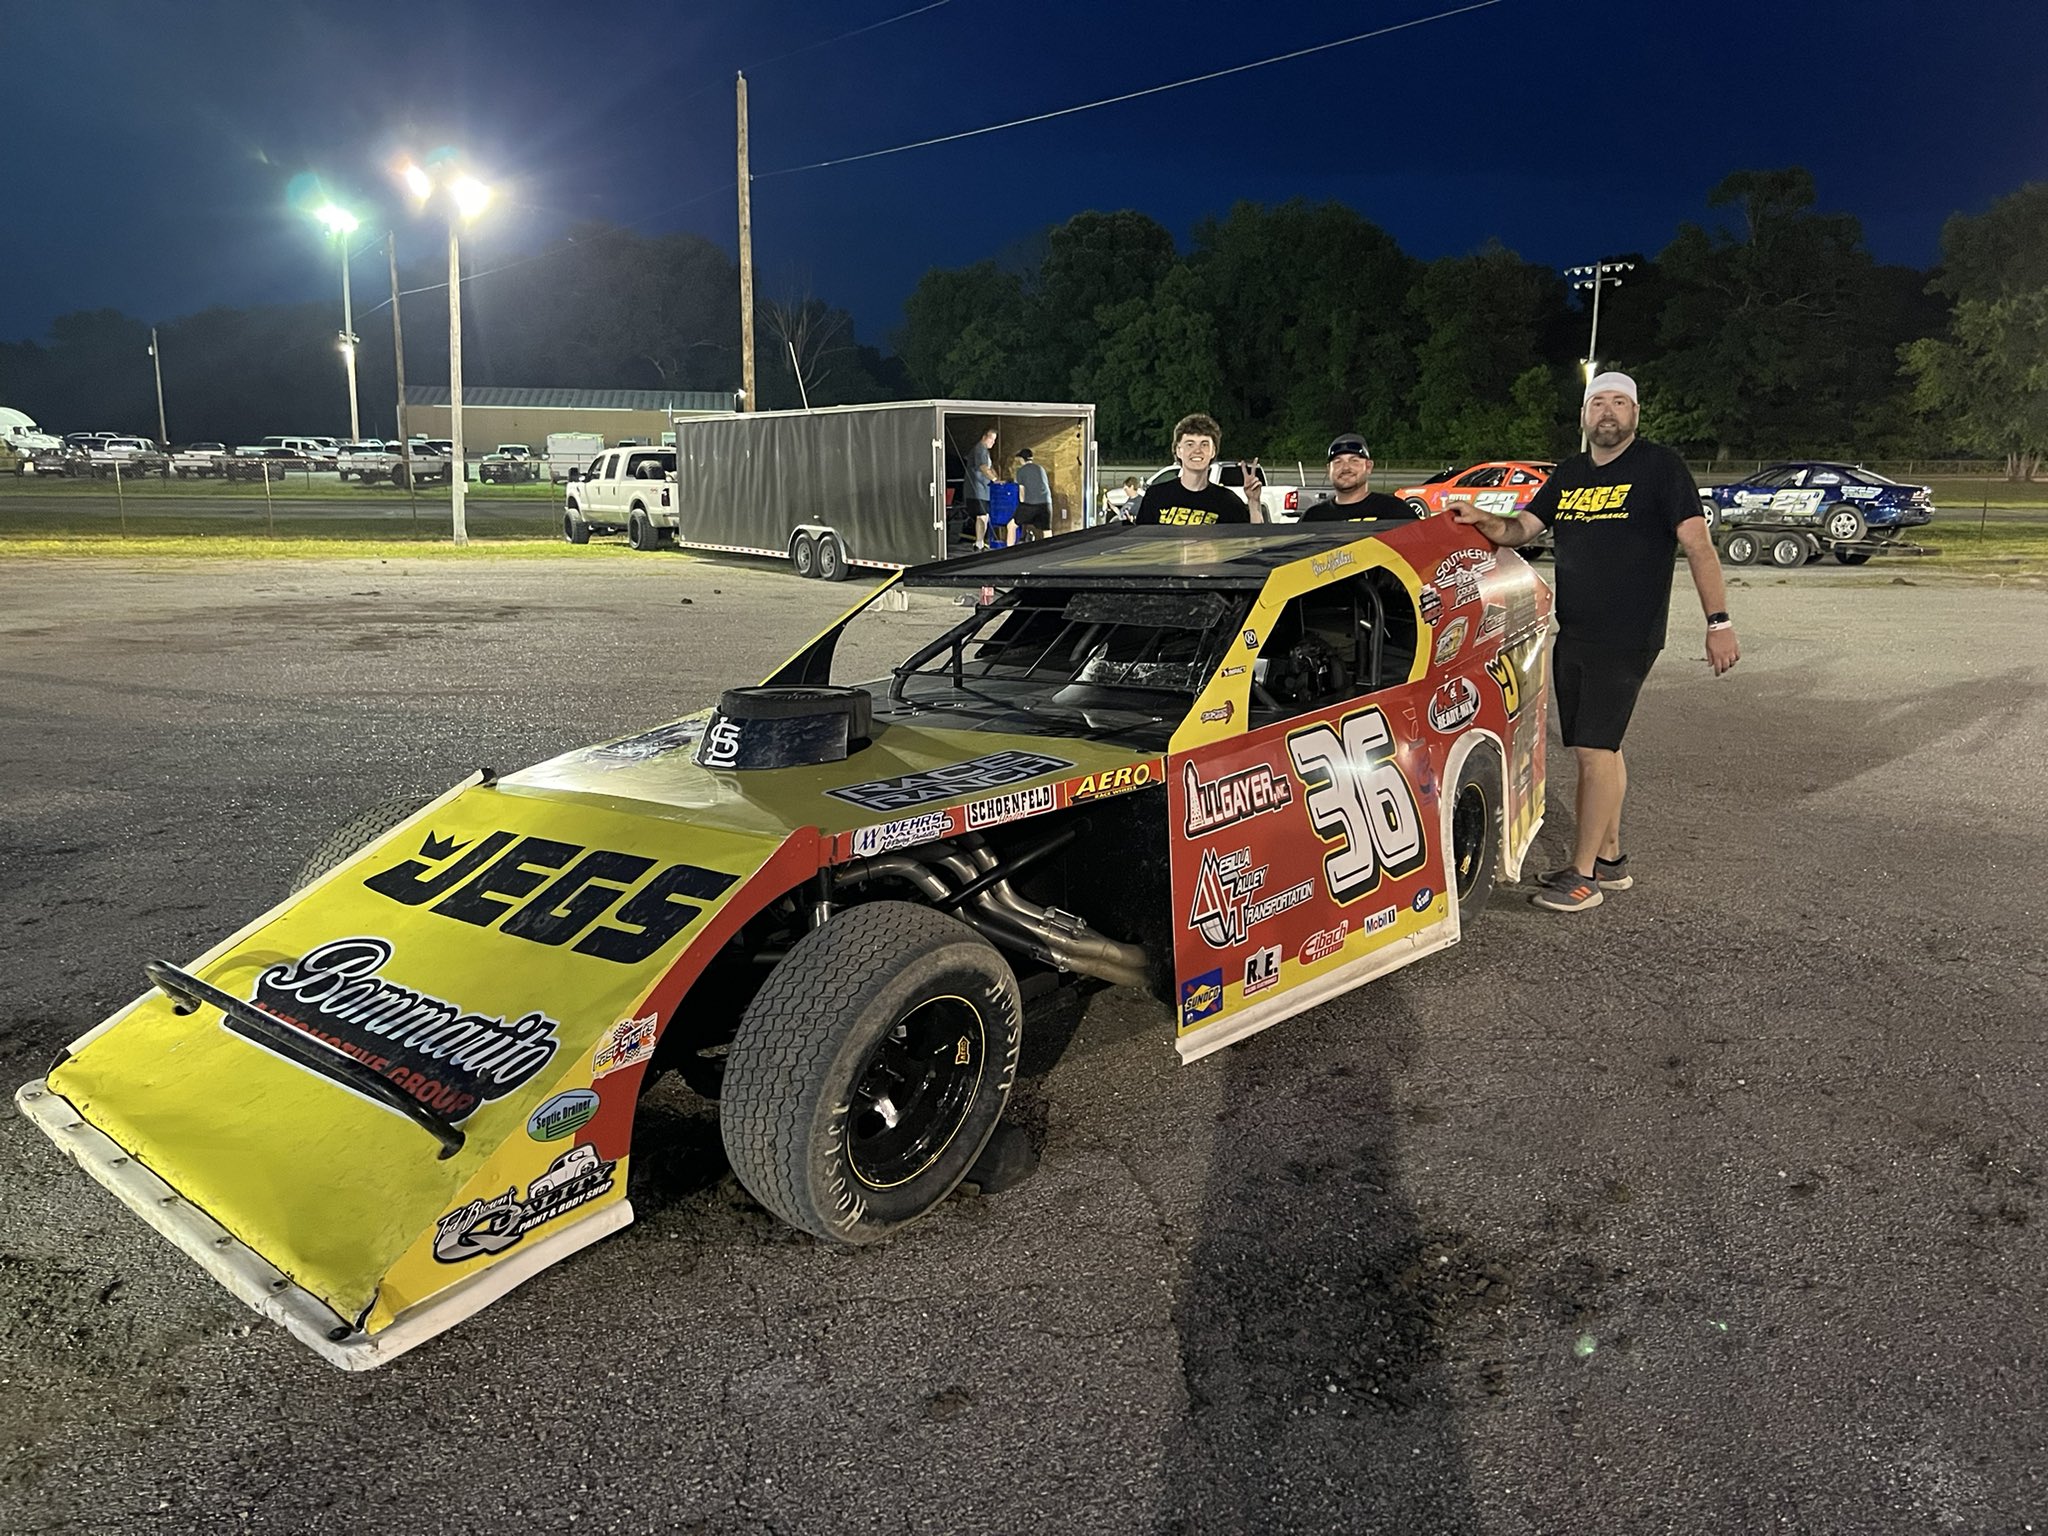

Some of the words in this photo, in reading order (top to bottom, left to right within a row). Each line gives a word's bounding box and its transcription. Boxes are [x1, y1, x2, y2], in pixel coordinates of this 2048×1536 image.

[1557, 484, 1632, 512] JEGS
[1435, 548, 1494, 581] SOUTHERN
[836, 752, 1016, 799] RACE
[864, 758, 1064, 809] RANCH
[1077, 763, 1151, 796] AERO
[971, 786, 1051, 823] SCHOENFELD
[1288, 708, 1424, 900] 36
[880, 820, 951, 841] MACHINE
[884, 812, 944, 834] WEHRS
[363, 830, 742, 964] JEGS
[1304, 922, 1348, 956] Eibach
[1366, 915, 1387, 934] Mobil
[1186, 985, 1220, 1011] SUNOCO
[387, 1066, 475, 1115] GROUP
[536, 1110, 562, 1131] Septic
[562, 1098, 592, 1120] Drainer
[518, 1211, 549, 1233] PAINT
[558, 1194, 586, 1213] BODY
[585, 1180, 613, 1200] SHOP
